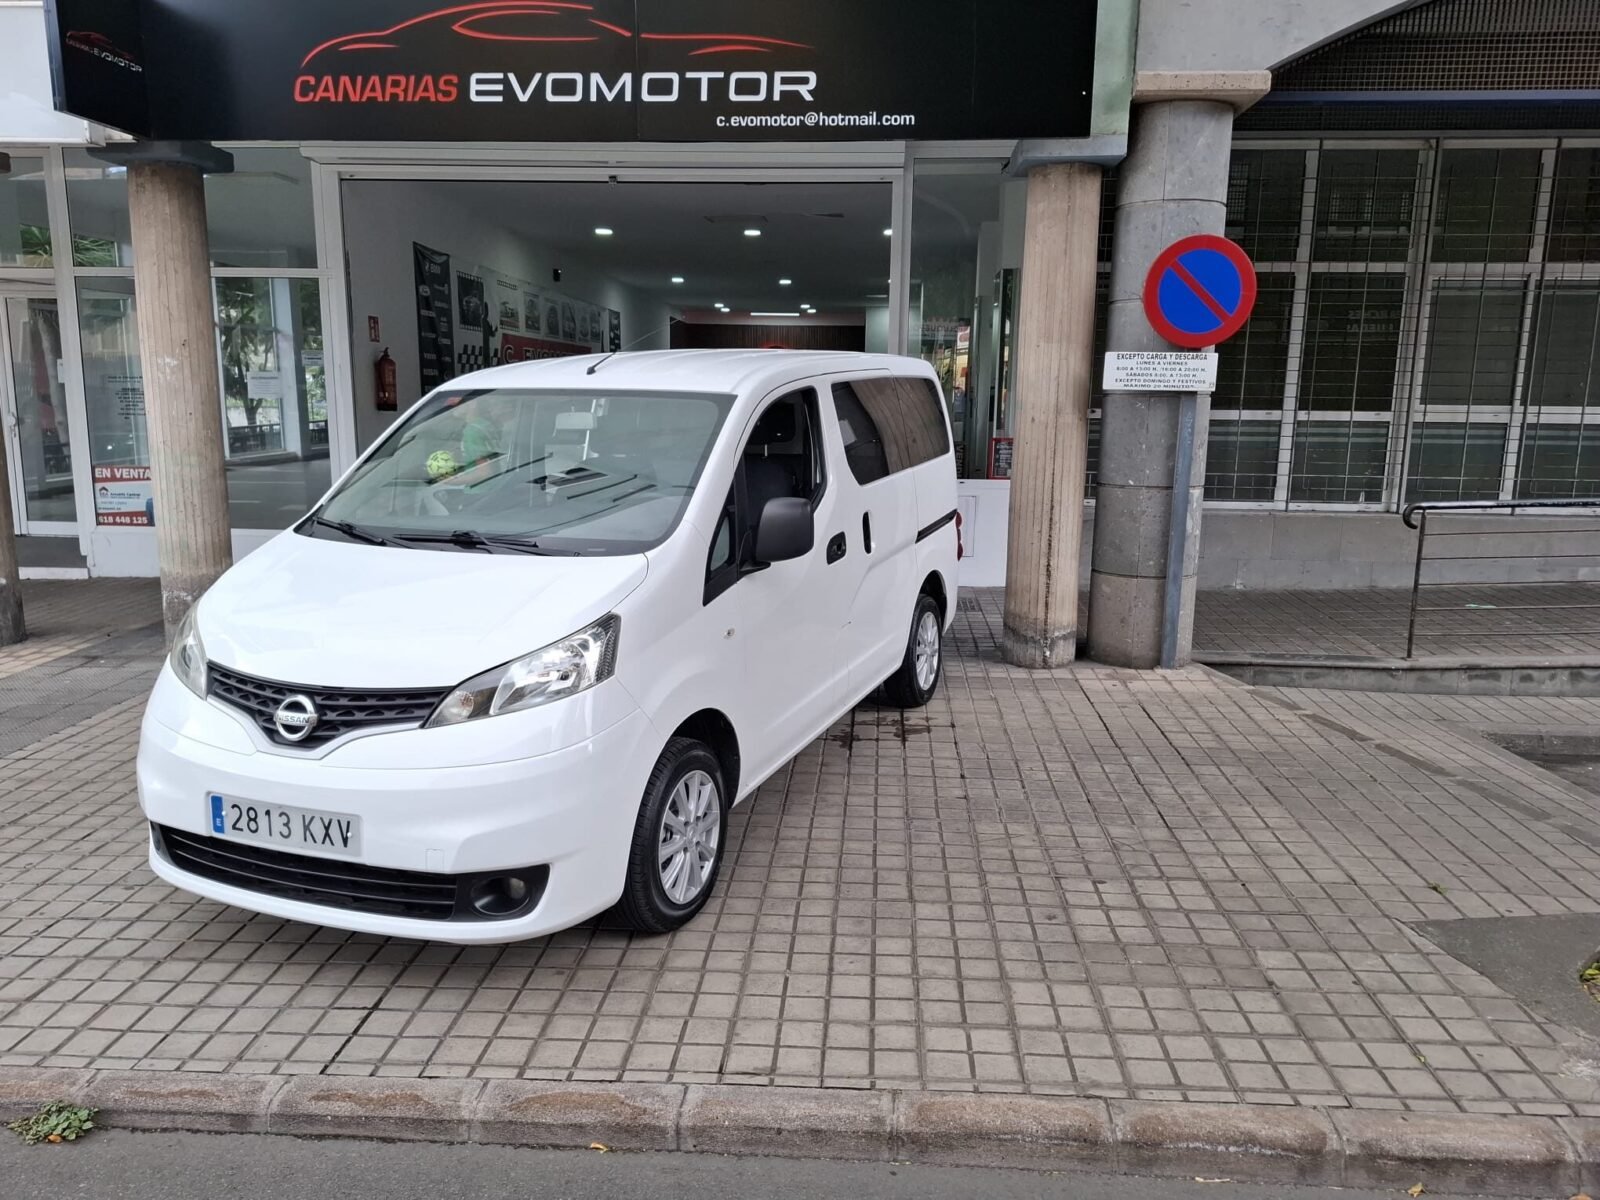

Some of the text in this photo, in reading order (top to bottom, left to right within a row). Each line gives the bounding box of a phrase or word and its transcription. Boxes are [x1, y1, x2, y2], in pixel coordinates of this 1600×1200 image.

[293, 70, 817, 103] CANARIAS EVOMOTOR
[716, 111, 915, 127] c.evomotor@hotmail.com
[1175, 353, 1208, 361] DESCARGA
[95, 467, 152, 479] EN VENTA
[278, 714, 310, 724] NISSAN
[231, 803, 351, 848] 2813 KXV
